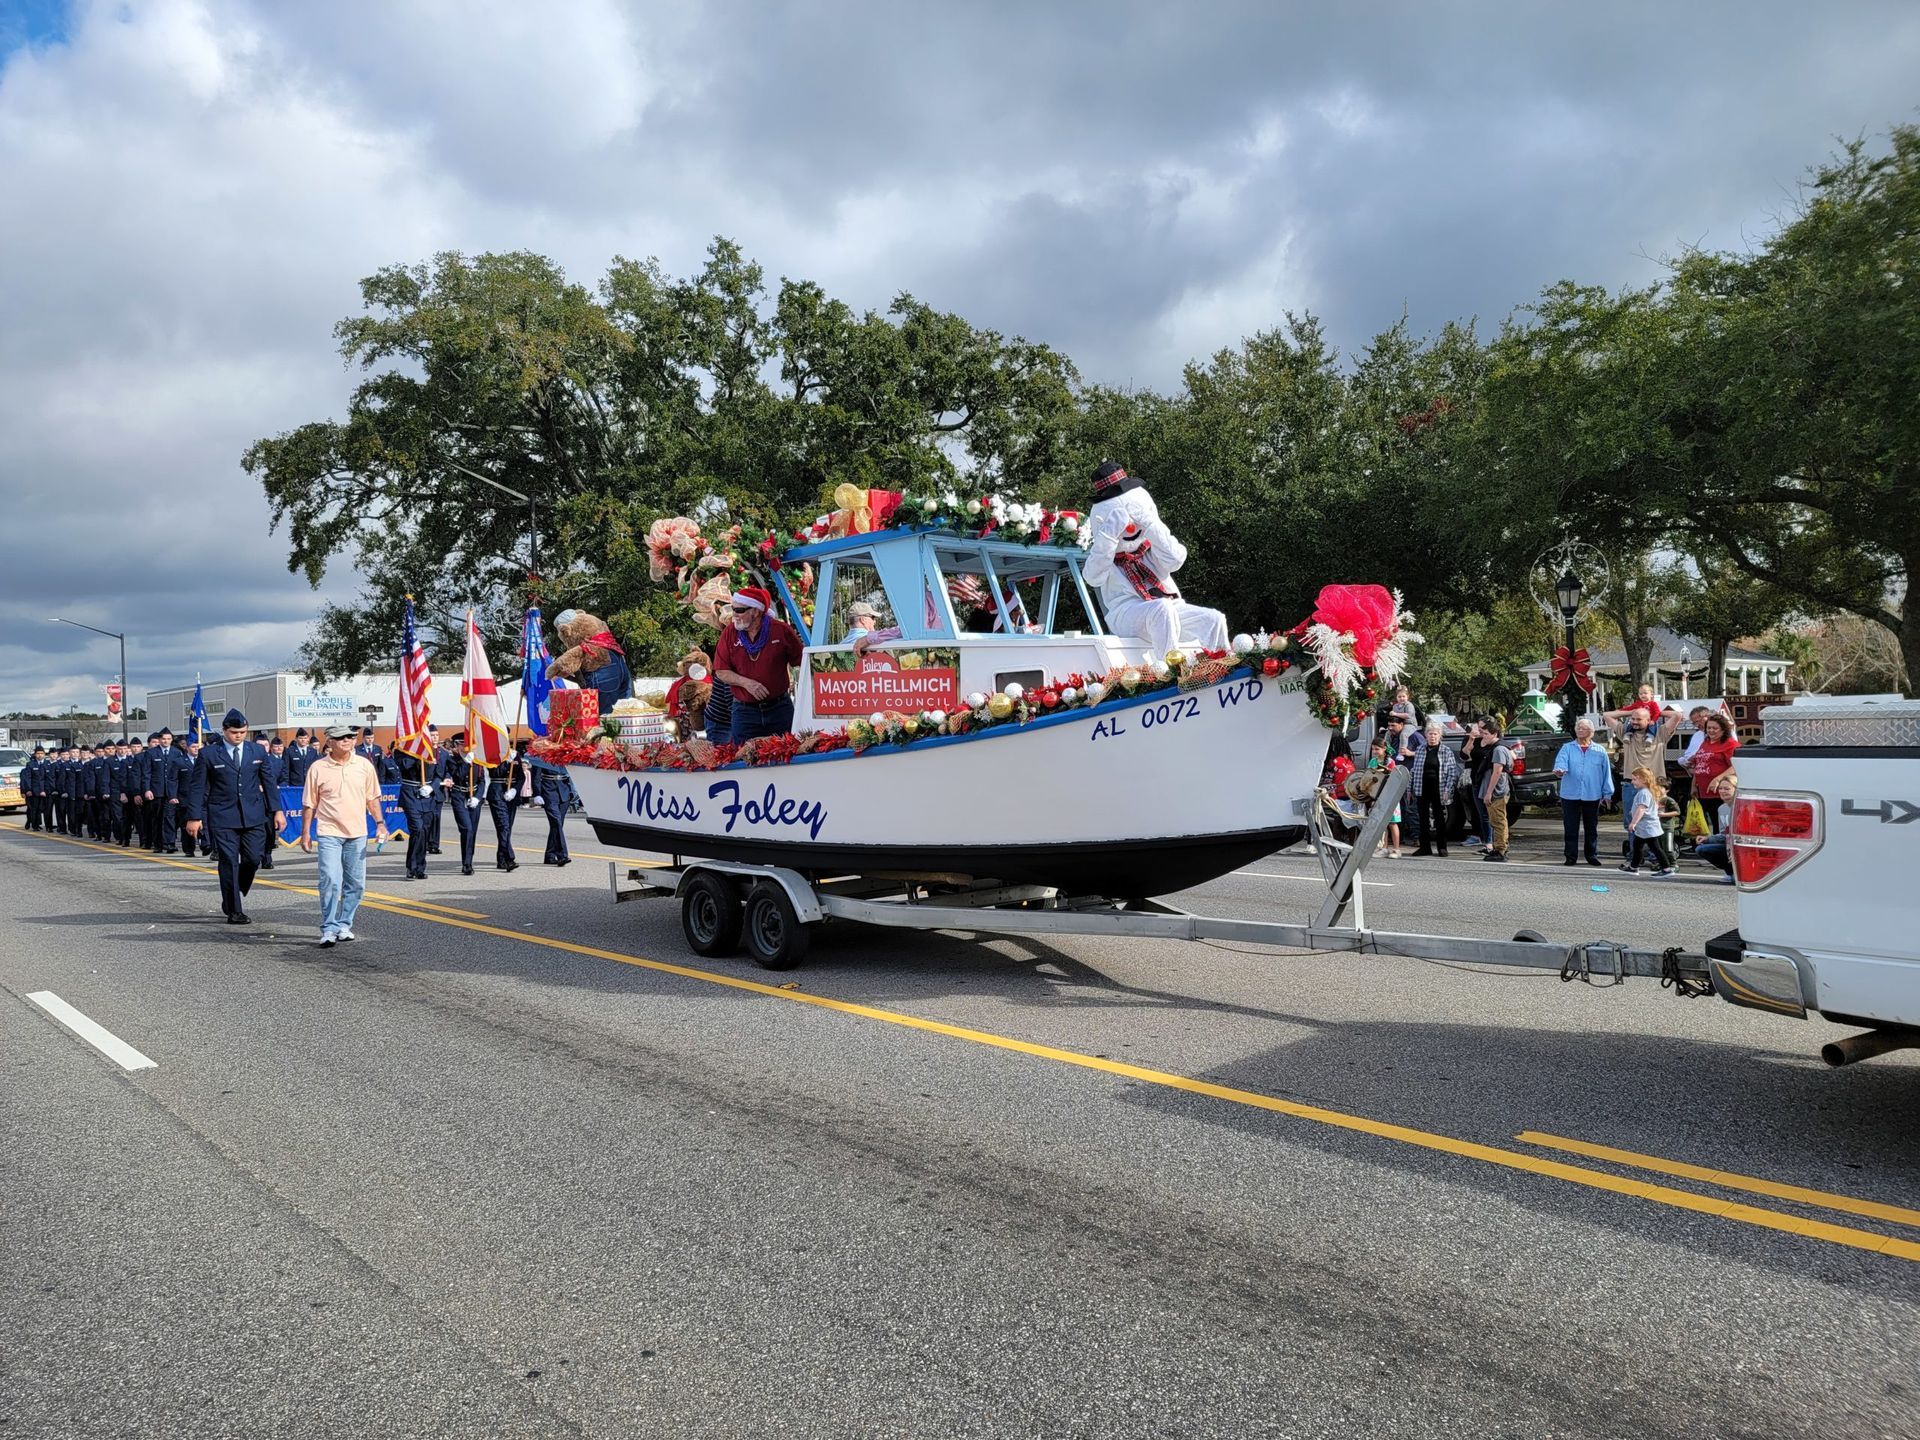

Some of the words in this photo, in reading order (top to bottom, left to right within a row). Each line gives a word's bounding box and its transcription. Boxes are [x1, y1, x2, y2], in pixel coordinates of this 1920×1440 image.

[862, 659, 882, 673] Foley
[820, 678, 867, 694] MAYOR
[871, 677, 951, 694] HELLMICH
[297, 699, 312, 708] BLP
[821, 699, 845, 707] AND
[851, 698, 879, 707] CITY
[885, 697, 950, 707] COUNCIL
[1091, 717, 1126, 741] AL
[1141, 697, 1200, 728] 0072
[1217, 679, 1263, 708] WD
[618, 776, 700, 821] Miss
[708, 780, 828, 841] Foley
